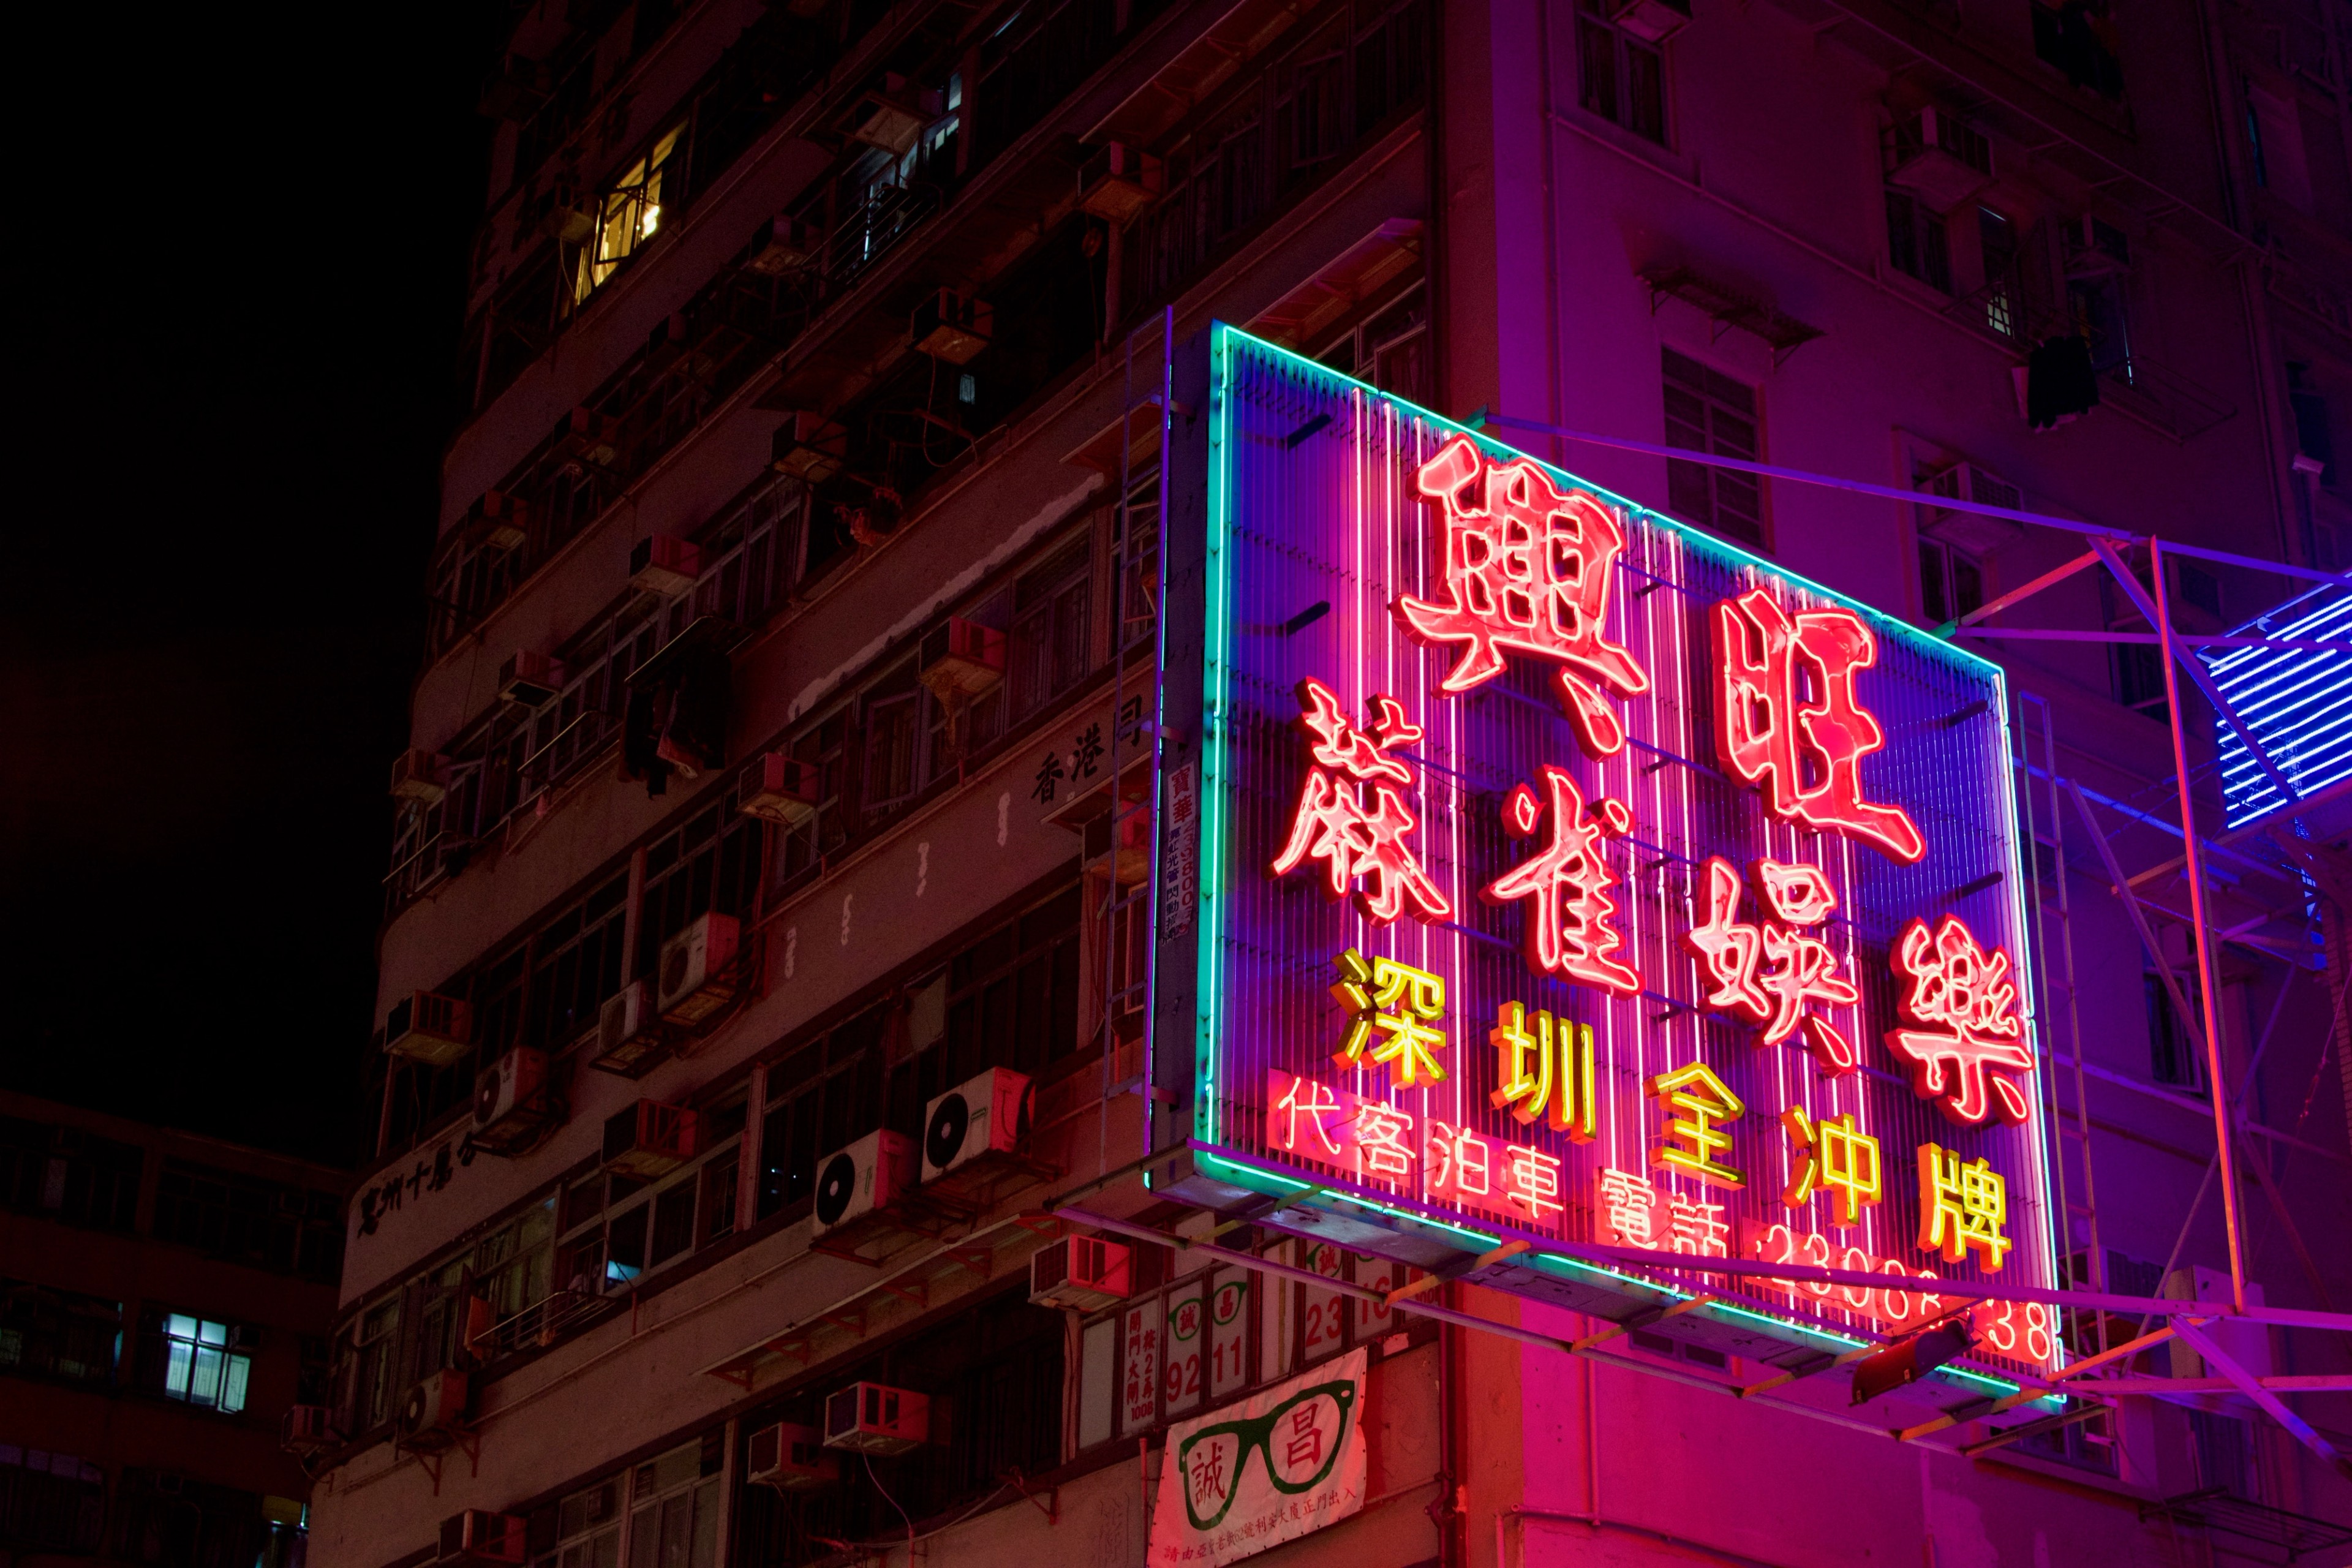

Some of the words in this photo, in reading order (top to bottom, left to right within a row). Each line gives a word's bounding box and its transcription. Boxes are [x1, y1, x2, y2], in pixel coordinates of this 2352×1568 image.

[1390, 432, 1926, 862] 興旺
[1278, 1077, 1564, 1218] 代客泊車
[1602, 1168, 1730, 1259] 電話
